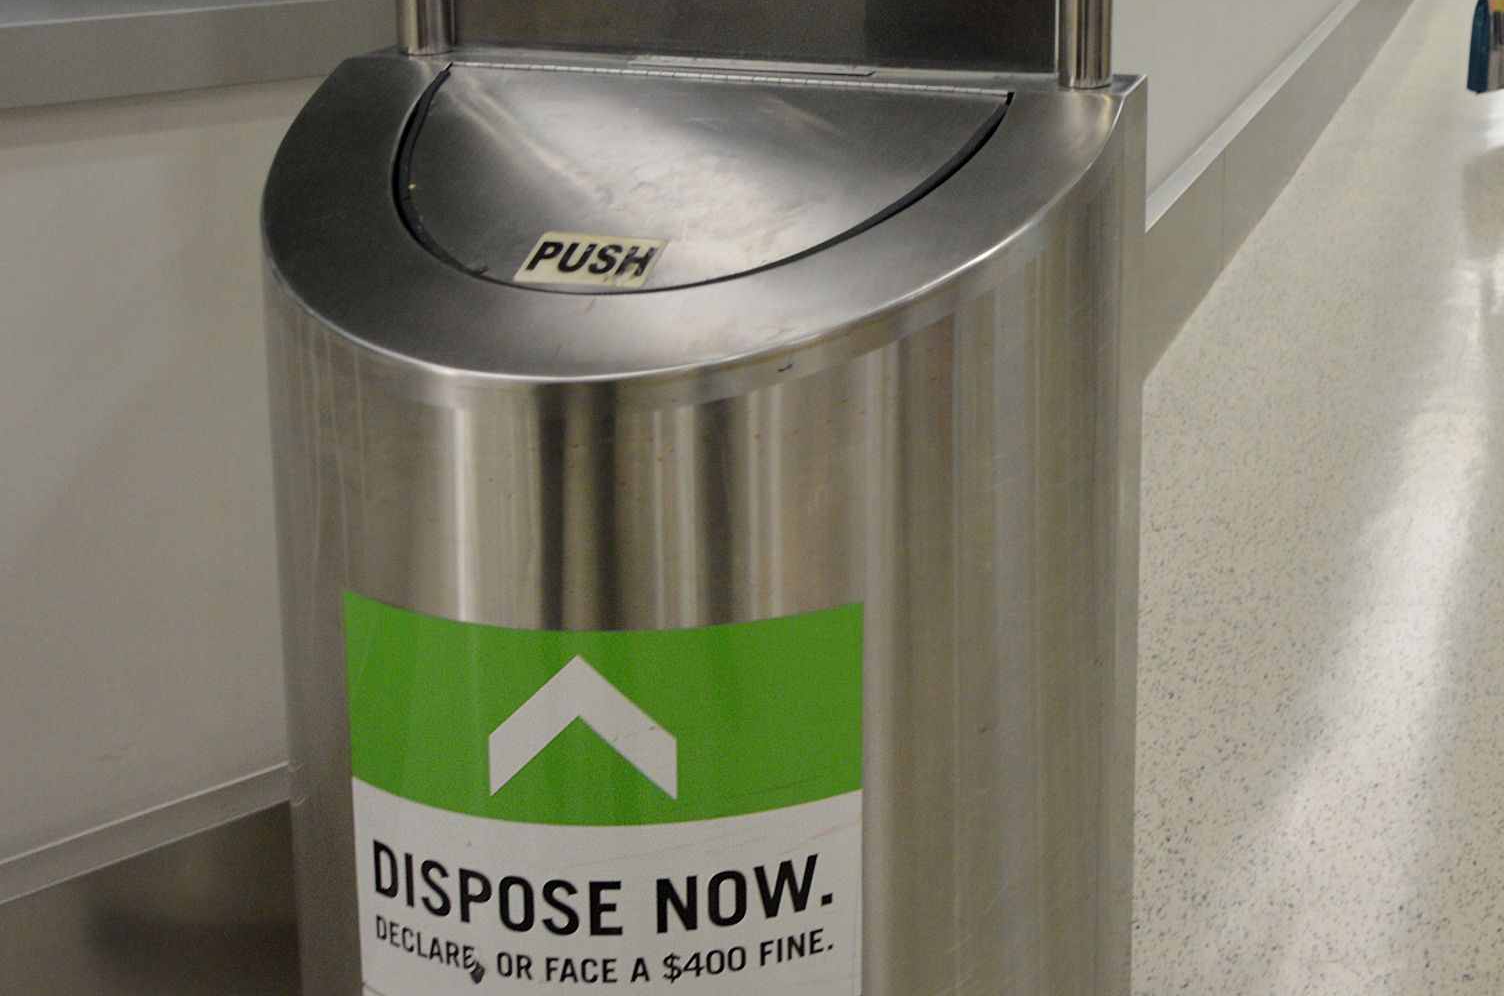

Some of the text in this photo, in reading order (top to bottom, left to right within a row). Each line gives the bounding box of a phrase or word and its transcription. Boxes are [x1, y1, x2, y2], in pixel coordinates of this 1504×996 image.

[525, 241, 657, 277] PUSH
[372, 839, 834, 937] DISPOSE NOW.
[496, 952, 533, 981] OR
[545, 957, 618, 985] FACE
[631, 958, 650, 983] A
[662, 945, 747, 983] $400
[759, 928, 834, 968] FINE.
